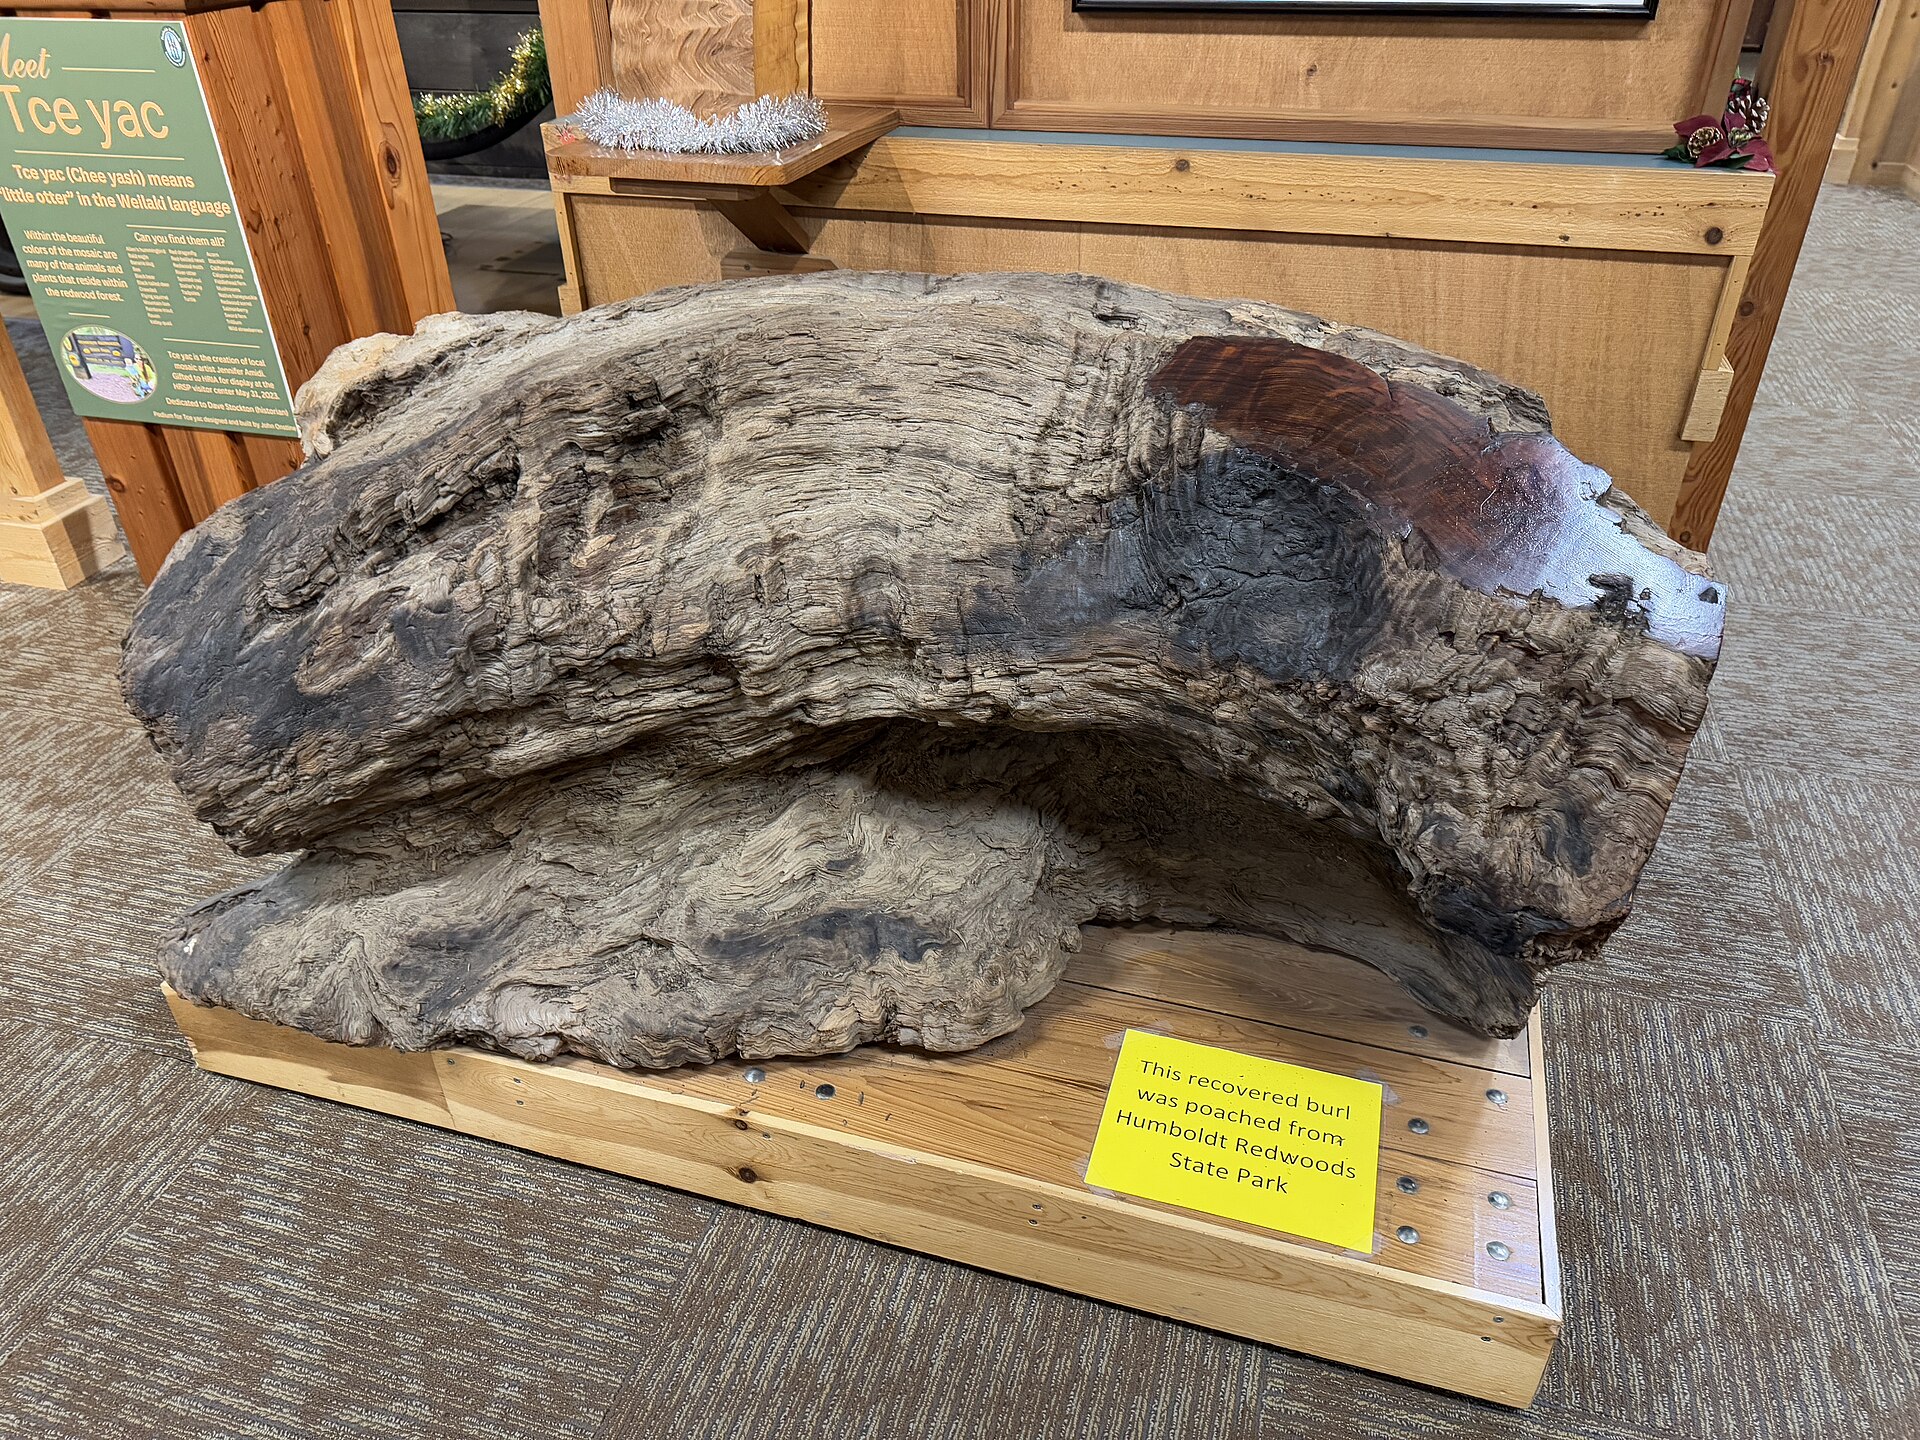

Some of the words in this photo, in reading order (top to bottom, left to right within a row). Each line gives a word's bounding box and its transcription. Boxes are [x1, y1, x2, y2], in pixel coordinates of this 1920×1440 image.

[0, 84, 82, 136] Tce
[85, 99, 169, 149] yac
[12, 164, 40, 180] Tce
[39, 168, 66, 184] yac
[66, 166, 106, 184] (Chee
[106, 169, 146, 188] yash)
[147, 174, 195, 188] means
[76, 191, 92, 206] in
[92, 192, 116, 208] the
[167, 196, 232, 218] language
[24, 230, 52, 241] Within
[51, 232, 66, 242] the
[66, 232, 106, 244] beautiful
[134, 232, 152, 242] Can
[150, 234, 168, 245] you
[168, 234, 186, 244] find
[186, 235, 210, 246] them
[210, 236, 226, 248] all?
[22, 244, 48, 255] colors
[48, 246, 58, 256] of
[58, 246, 73, 256] the
[72, 248, 103, 259] mosaic
[103, 250, 118, 260] are
[26, 260, 49, 271] many
[50, 260, 60, 270] of
[59, 260, 74, 270] the
[74, 262, 106, 273] animals
[106, 264, 124, 274] and
[32, 272, 58, 284] plants
[57, 274, 76, 284] that
[76, 276, 102, 286] reside
[101, 278, 128, 288] within
[44, 287, 60, 297] the
[60, 288, 97, 300] redwood
[96, 290, 124, 302] forest.
[174, 364, 198, 372] mosaic
[200, 354, 212, 362] the
[212, 355, 240, 364] creation
[248, 358, 266, 367] local
[213, 386, 235, 396] center
[218, 376, 230, 384] for
[230, 378, 254, 388] display
[262, 381, 275, 390] the
[166, 397, 200, 408] Dedicated
[206, 402, 225, 410] Dave
[224, 403, 255, 412] Stockton
[1140, 1060, 1181, 1081] This
[1188, 1070, 1299, 1108] recovered
[1307, 1096, 1350, 1120] burl
[1137, 1090, 1178, 1108] was
[1185, 1100, 1280, 1132] poached
[1288, 1120, 1346, 1147] from
[1116, 1110, 1227, 1149] Humboldt
[1236, 1137, 1356, 1179] Redwoods
[1169, 1152, 1229, 1180] State
[1237, 1168, 1288, 1194] Park
